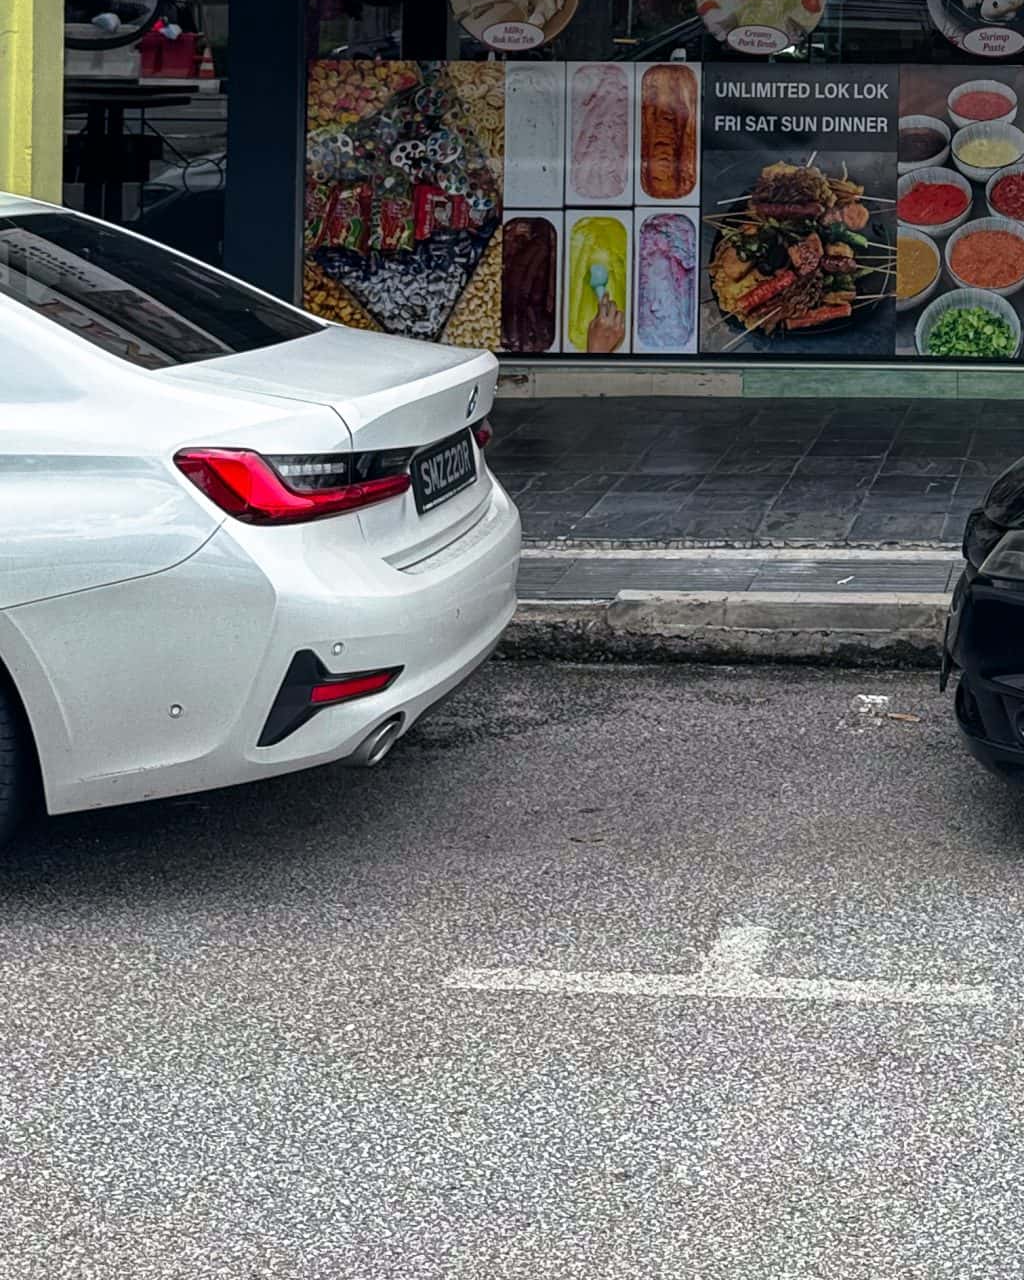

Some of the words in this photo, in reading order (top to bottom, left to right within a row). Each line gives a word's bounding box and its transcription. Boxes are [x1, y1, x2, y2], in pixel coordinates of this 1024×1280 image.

[978, 32, 1010, 44] Shrimp
[982, 42, 1006, 52] Paste
[715, 82, 810, 99] UNLIMITED
[815, 82, 849, 99] LOK
[853, 83, 889, 99] LOK
[714, 115, 742, 132] FRI
[745, 115, 779, 133] SAT
[781, 115, 817, 133] SUN
[821, 116, 888, 133] DINNER
[421, 440, 472, 495] SMZ220R
